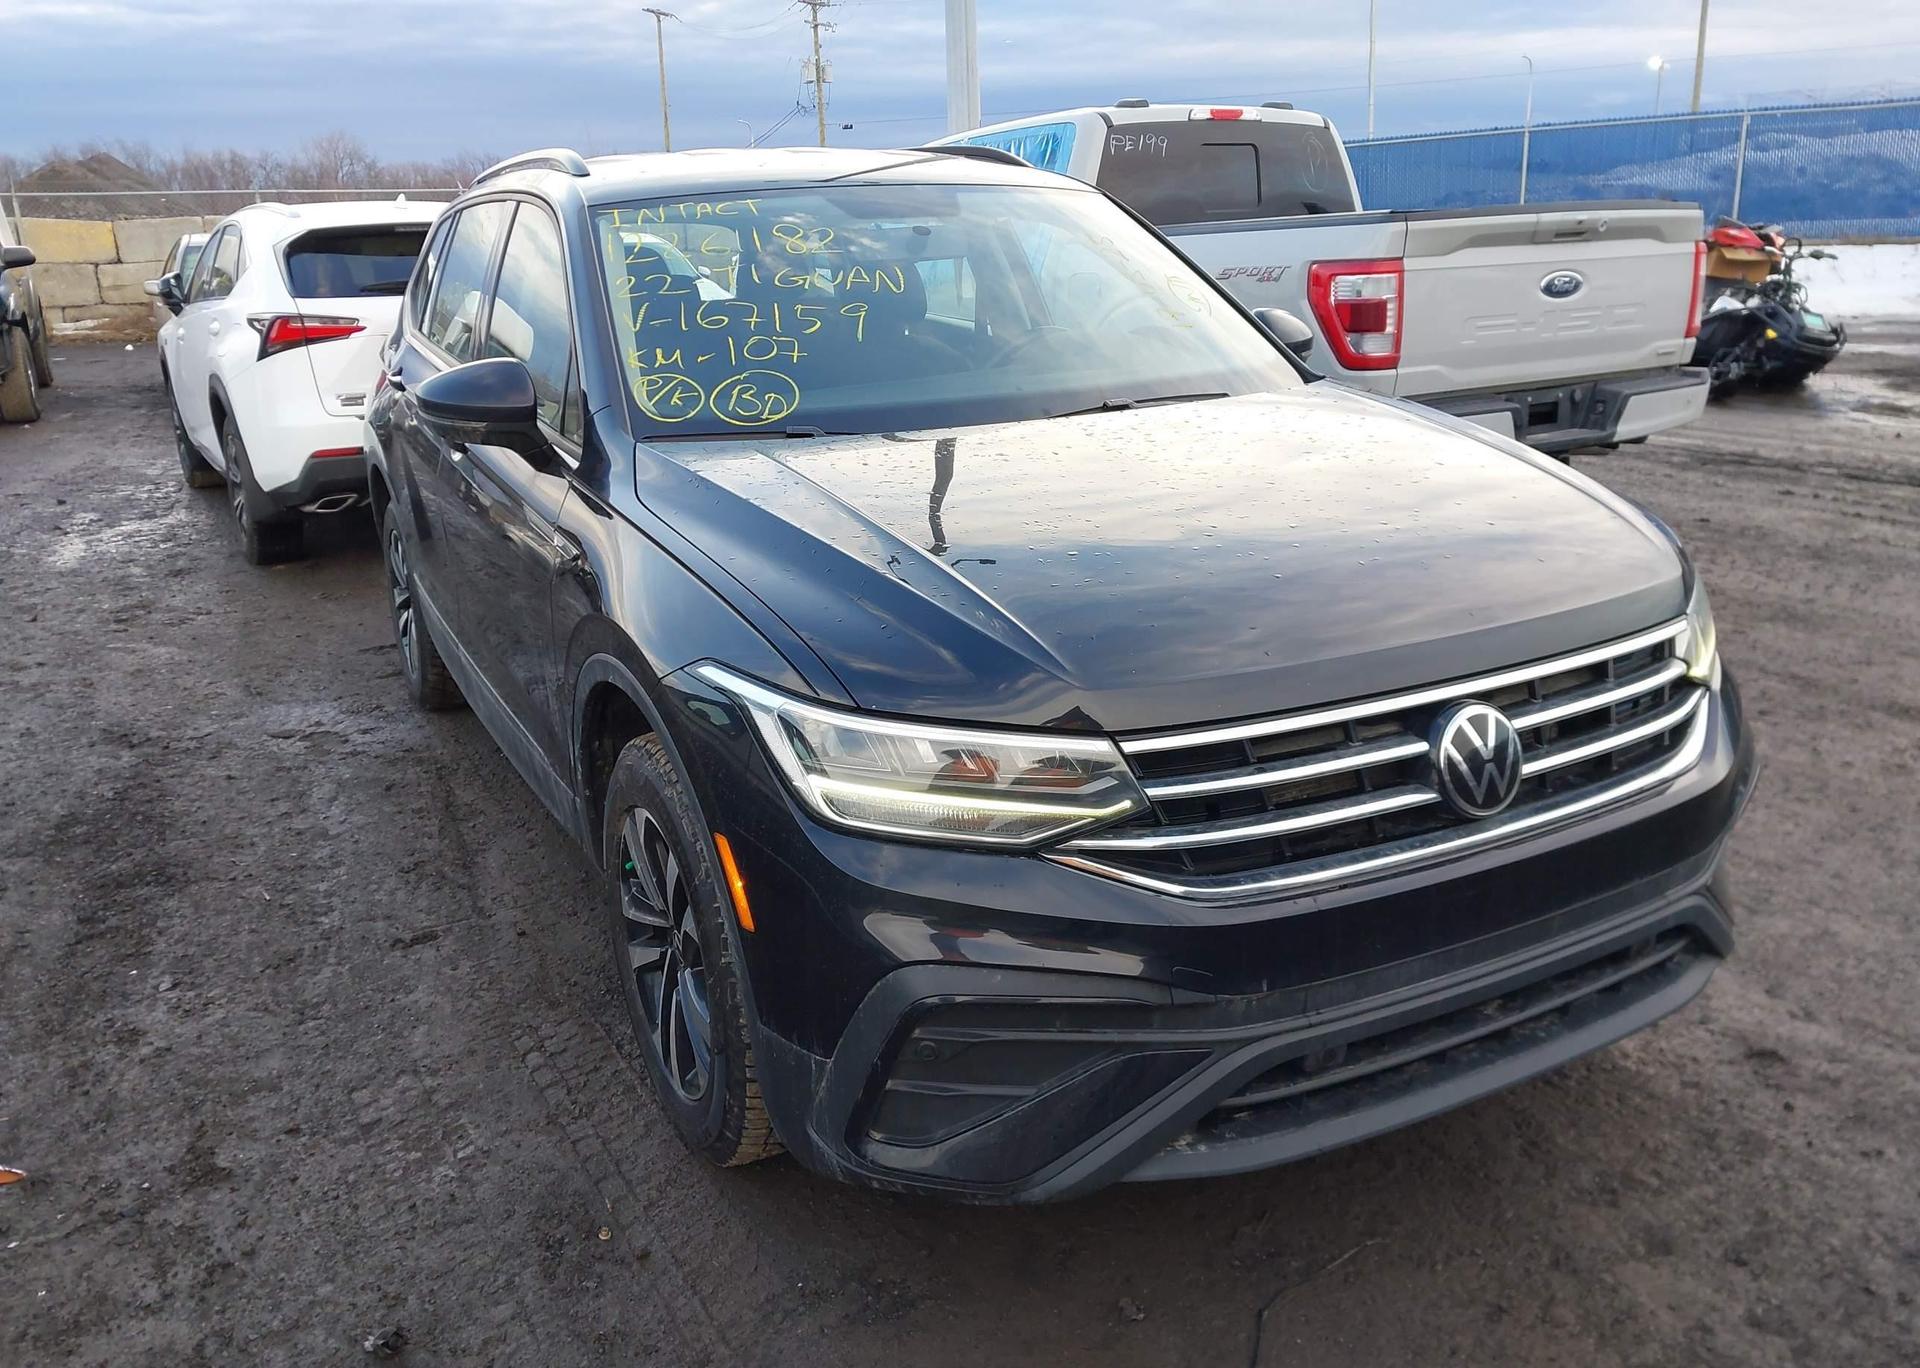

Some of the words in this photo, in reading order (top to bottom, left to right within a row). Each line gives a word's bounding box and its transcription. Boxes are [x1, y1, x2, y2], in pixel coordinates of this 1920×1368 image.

[1109, 133, 1169, 157] PE199
[597, 199, 762, 227] INTACT
[711, 262, 906, 293] TIGUAN
[1215, 266, 1292, 280] SPORT
[1441, 703, 1521, 815] VW
